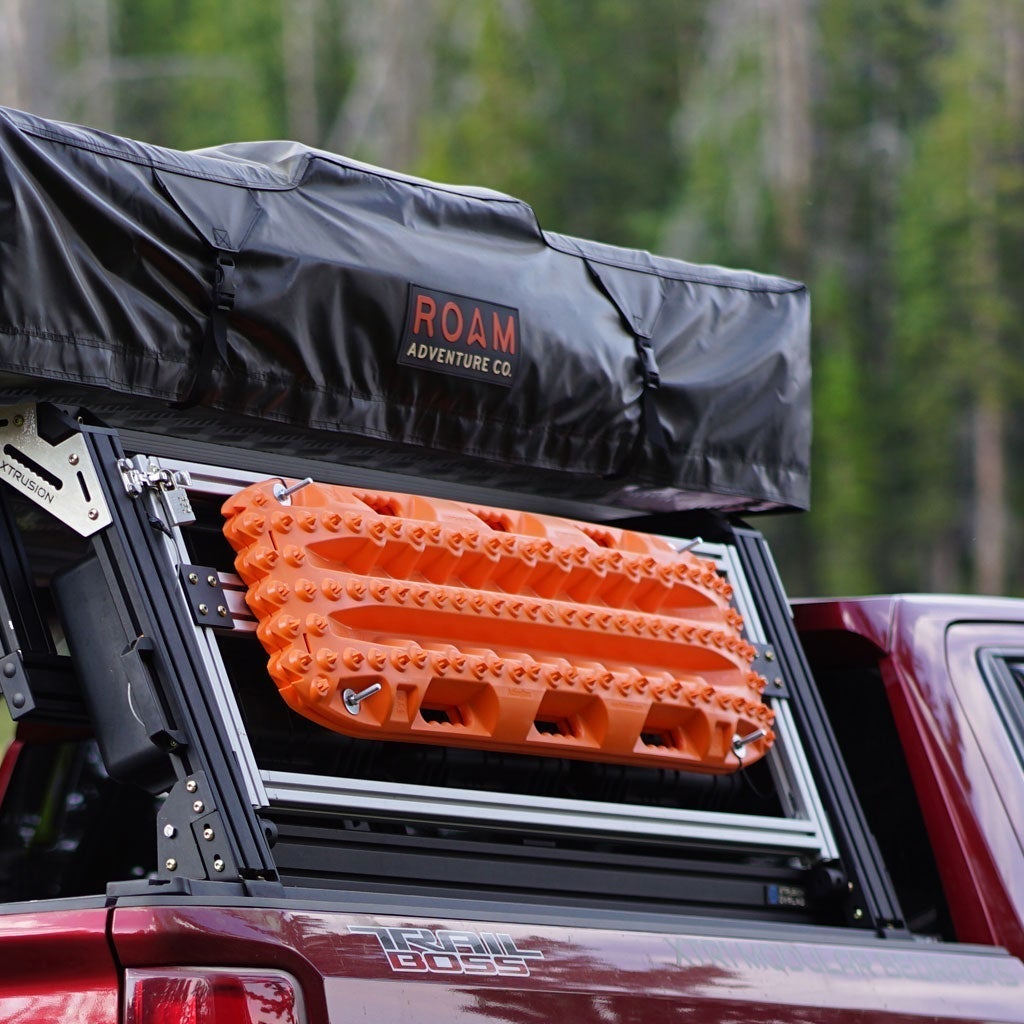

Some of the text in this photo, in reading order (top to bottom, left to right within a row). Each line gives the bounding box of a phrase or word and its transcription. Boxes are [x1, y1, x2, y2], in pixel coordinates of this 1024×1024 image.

[413, 294, 515, 355] ROAM
[406, 342, 490, 373] ADVENTURE
[0, 460, 55, 505] XTRUSION
[347, 924, 545, 960] TRAIL
[384, 950, 531, 977] BOSS
